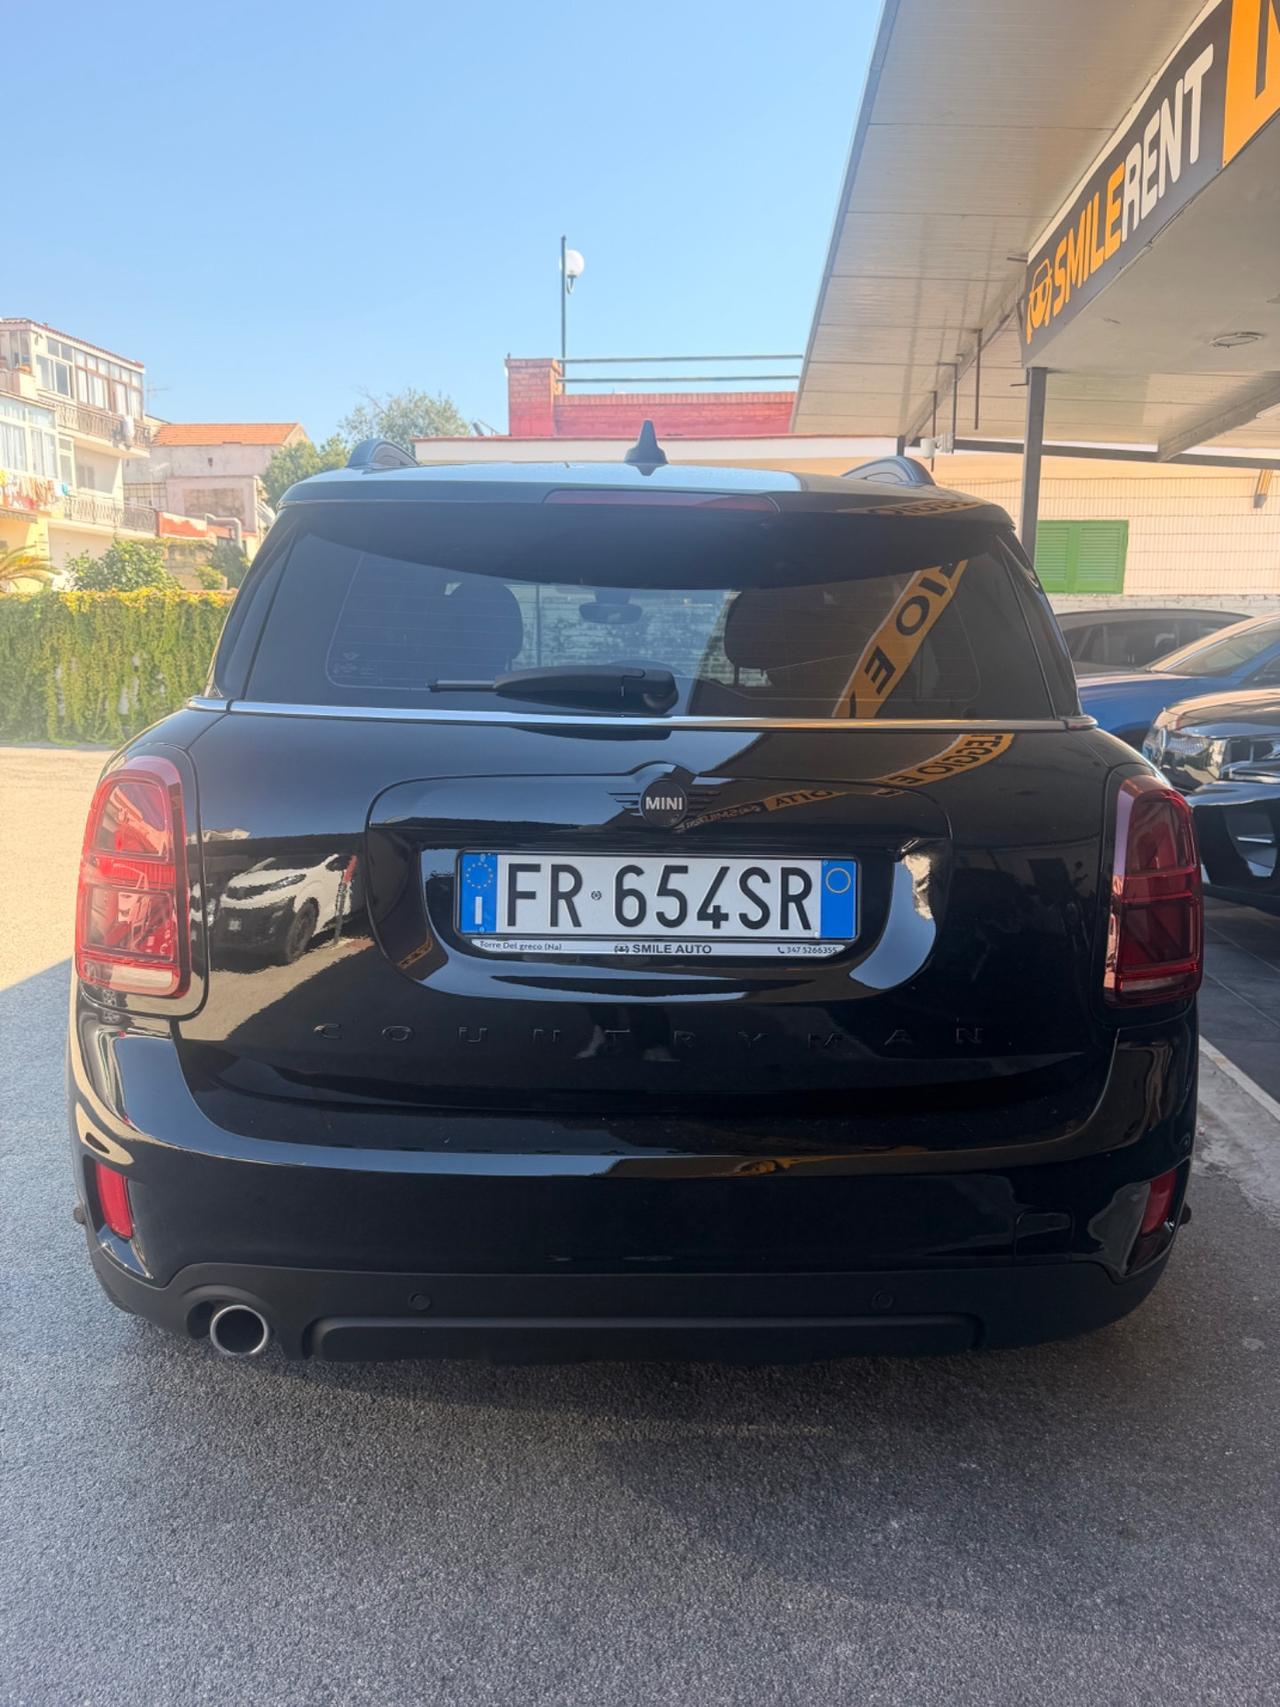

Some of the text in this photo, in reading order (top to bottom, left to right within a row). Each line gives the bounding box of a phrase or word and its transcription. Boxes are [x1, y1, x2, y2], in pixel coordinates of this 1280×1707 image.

[645, 796, 683, 810] MINI
[506, 863, 583, 928] FR
[479, 940, 501, 949] Torre
[503, 941, 518, 949] Del
[519, 943, 543, 951] greco
[633, 944, 712, 955] SMILE AUTO
